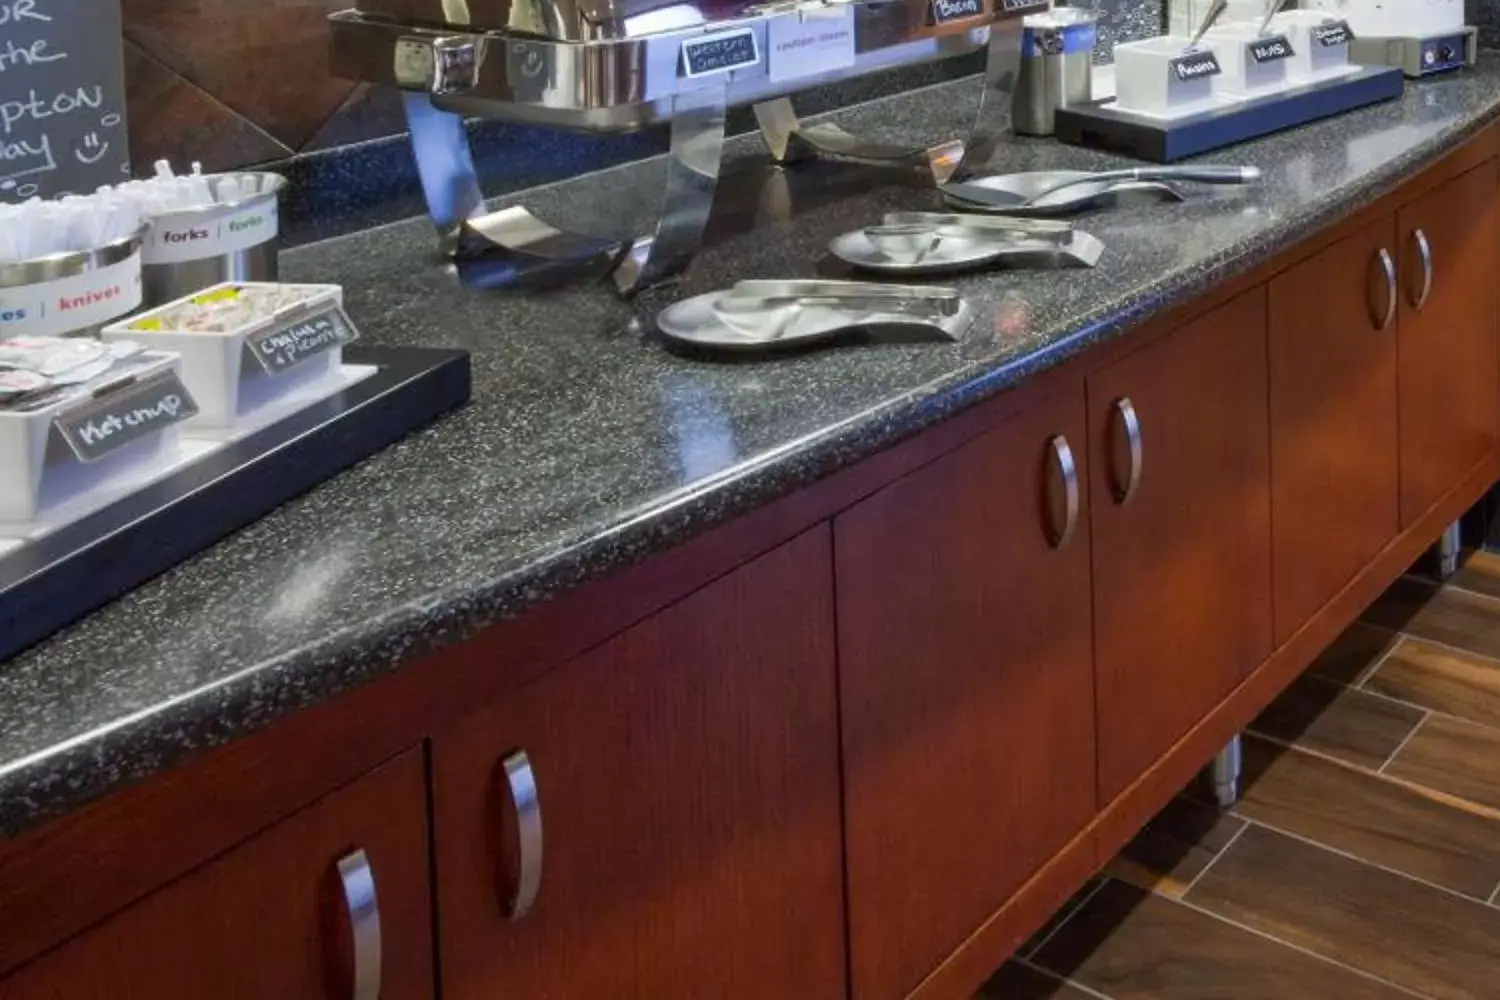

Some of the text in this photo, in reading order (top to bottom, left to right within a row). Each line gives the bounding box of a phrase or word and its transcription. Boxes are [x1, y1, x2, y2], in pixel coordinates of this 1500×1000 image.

[164, 215, 263, 243] forks forks
[59, 286, 121, 311] knives
[77, 394, 182, 446] Ketchup
